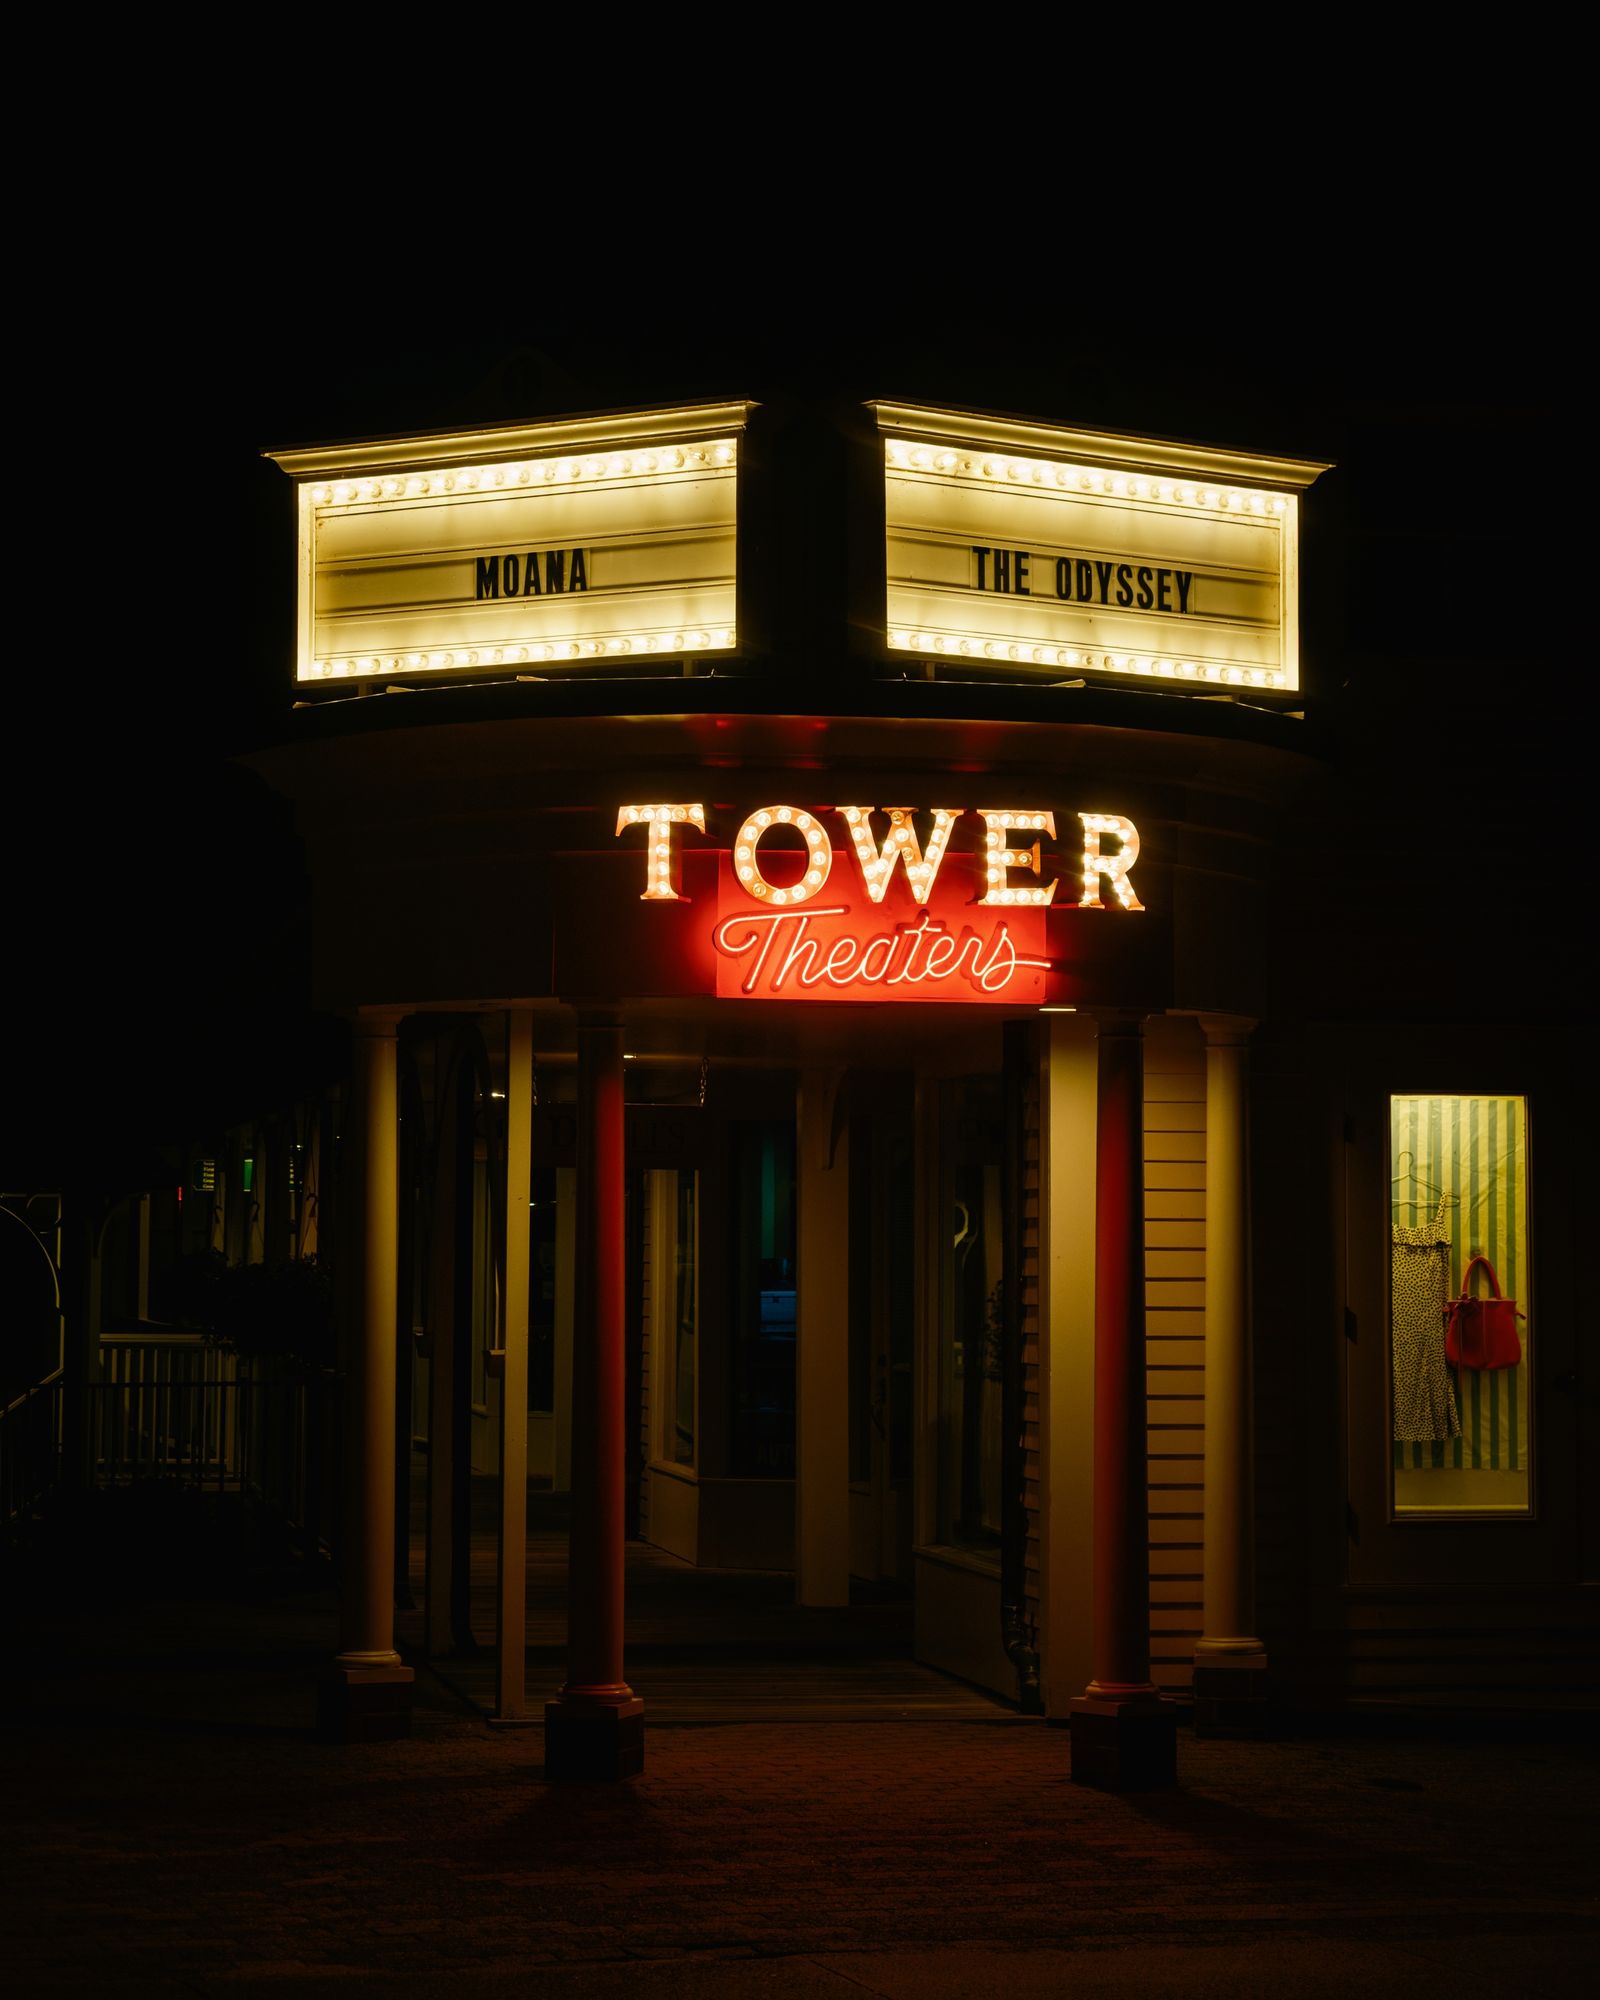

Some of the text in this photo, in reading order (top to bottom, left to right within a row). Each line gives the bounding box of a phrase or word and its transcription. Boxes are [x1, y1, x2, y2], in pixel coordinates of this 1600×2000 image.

[476, 548, 588, 601] MOANA
[972, 546, 1193, 614] THE ODYSSEY
[615, 802, 1146, 911] TOWER
[715, 906, 1052, 992] Theaters
